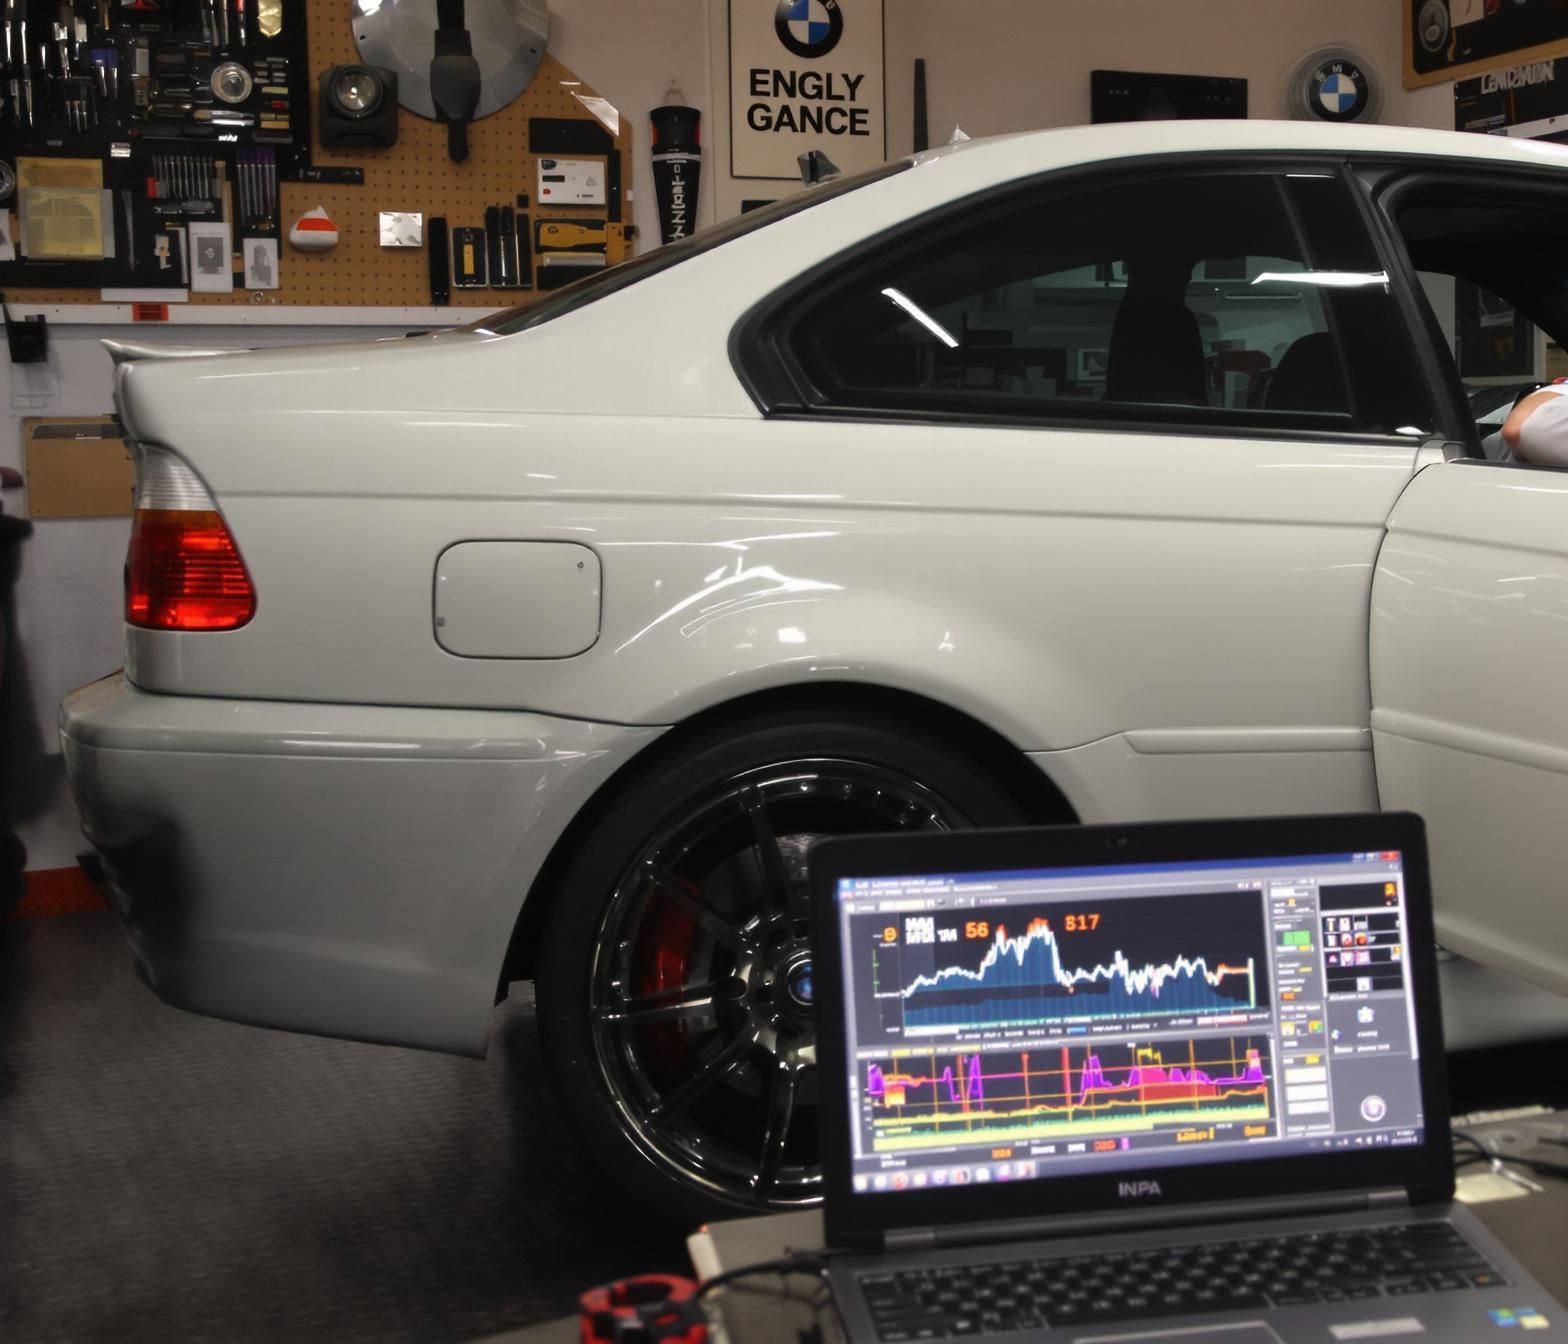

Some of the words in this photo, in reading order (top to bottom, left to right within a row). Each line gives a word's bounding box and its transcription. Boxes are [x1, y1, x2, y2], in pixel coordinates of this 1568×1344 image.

[749, 68, 865, 102] ENGLY
[746, 103, 870, 136] GANCE
[965, 921, 989, 939] 56
[1118, 1180, 1162, 1197] INPA
